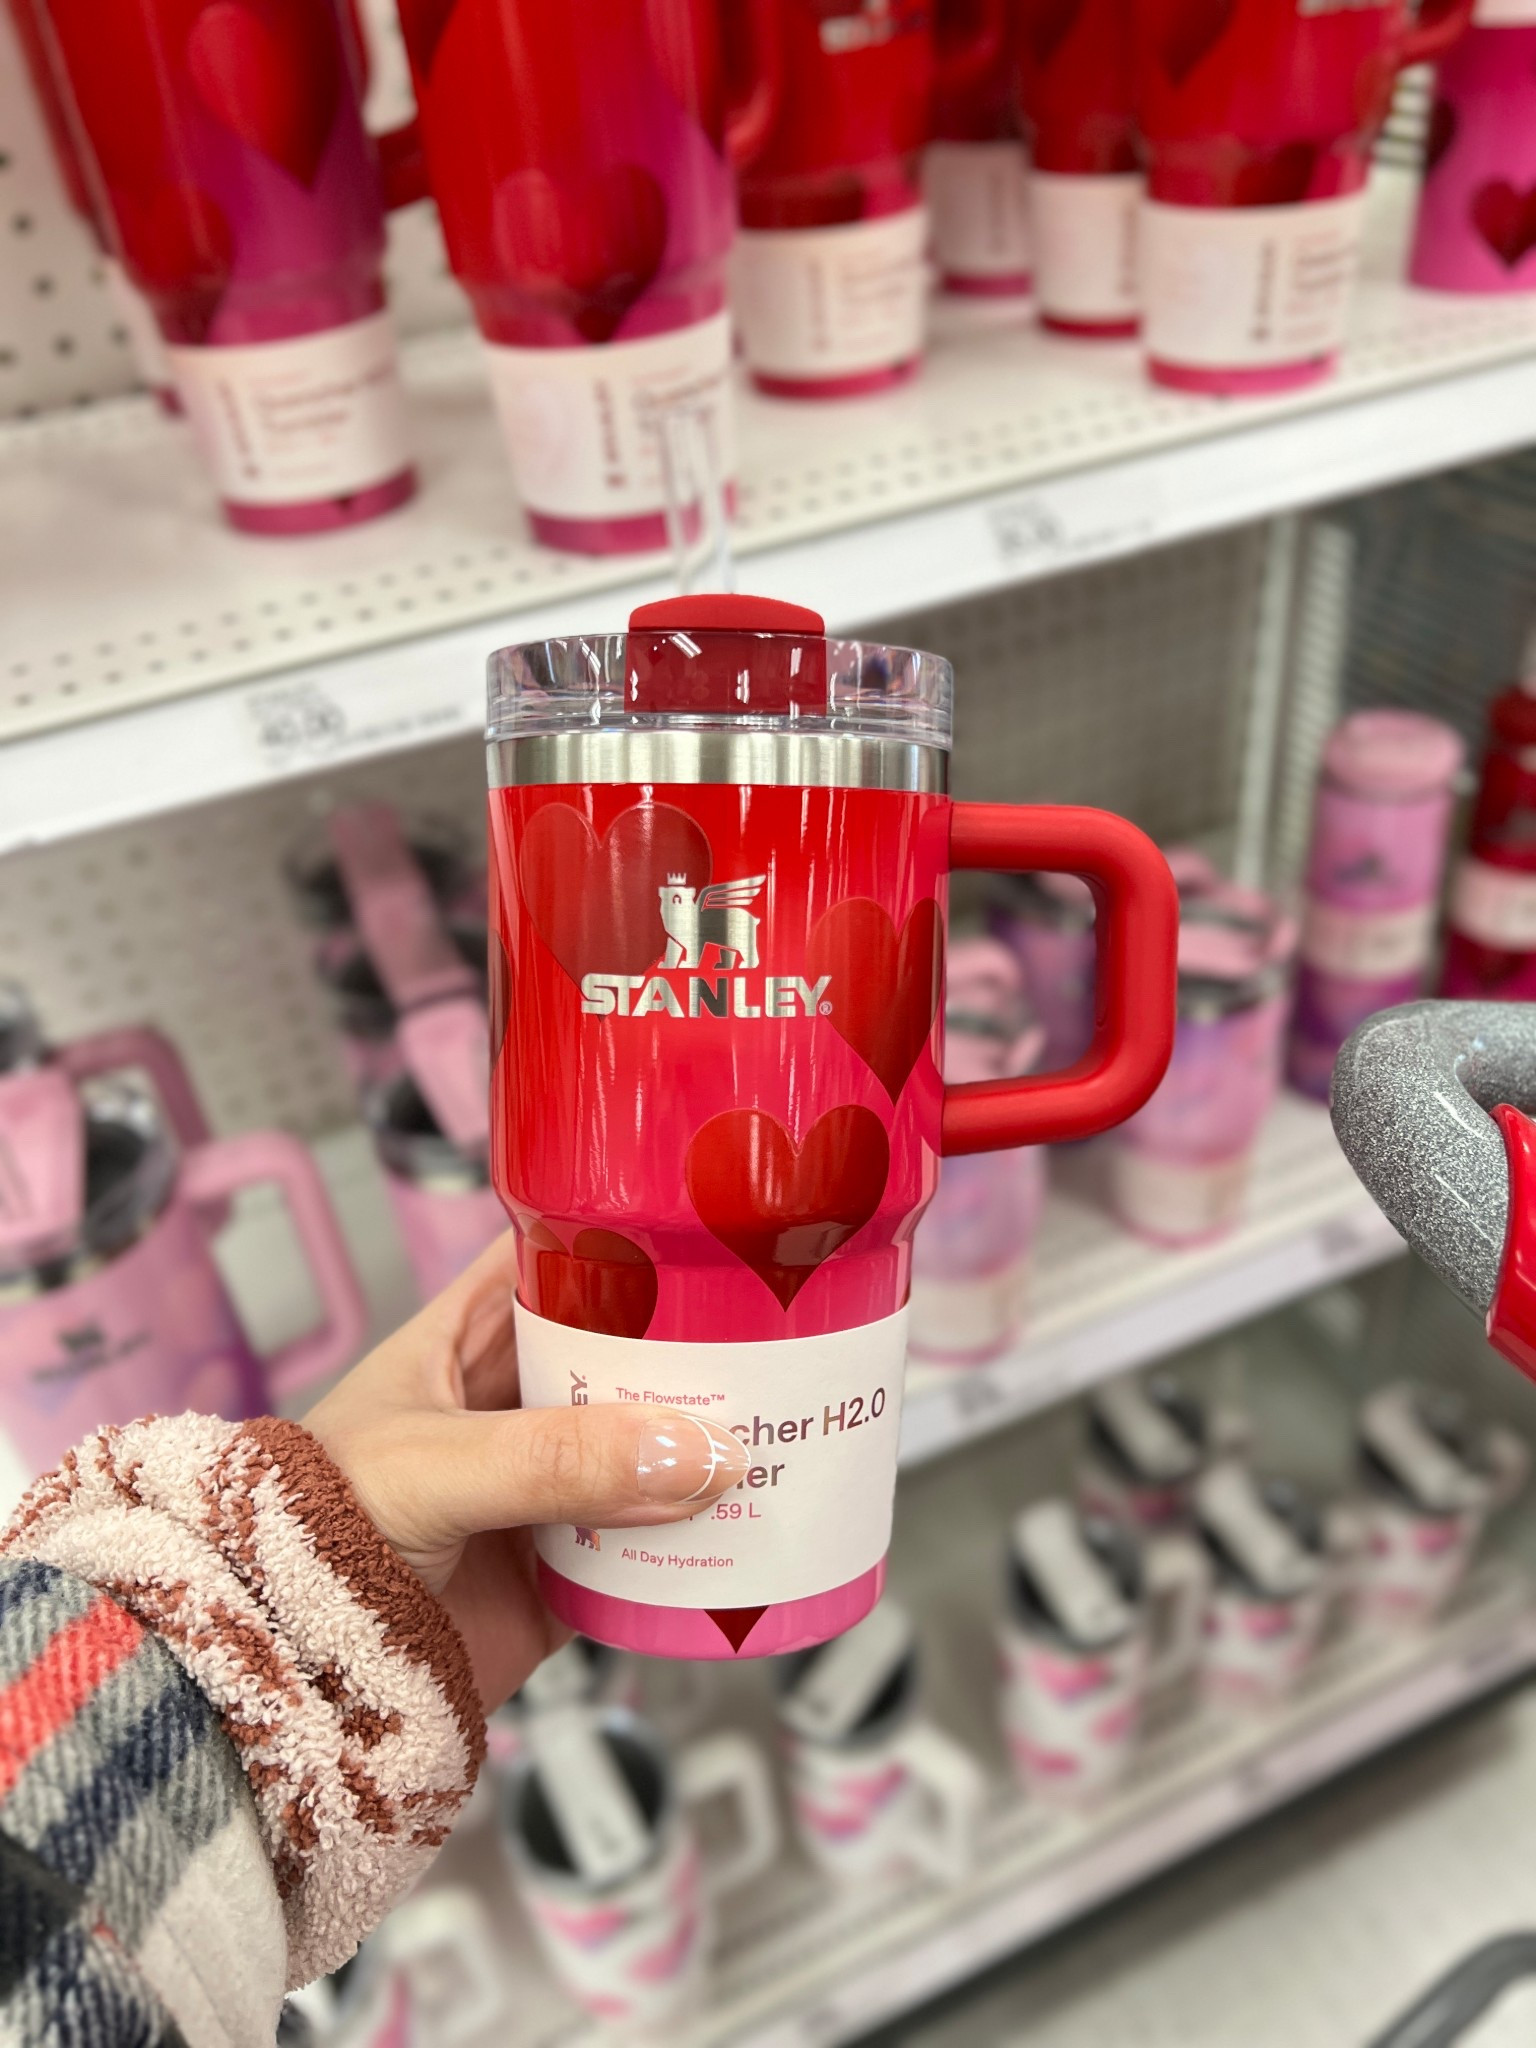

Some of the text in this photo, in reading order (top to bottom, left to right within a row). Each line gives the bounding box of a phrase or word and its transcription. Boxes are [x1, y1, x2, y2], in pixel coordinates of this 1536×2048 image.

[615, 1387, 640, 1401] The
[822, 1387, 886, 1436] H2.0
[748, 1502, 762, 1518] L
[621, 1547, 734, 1569] All Day Hydration
